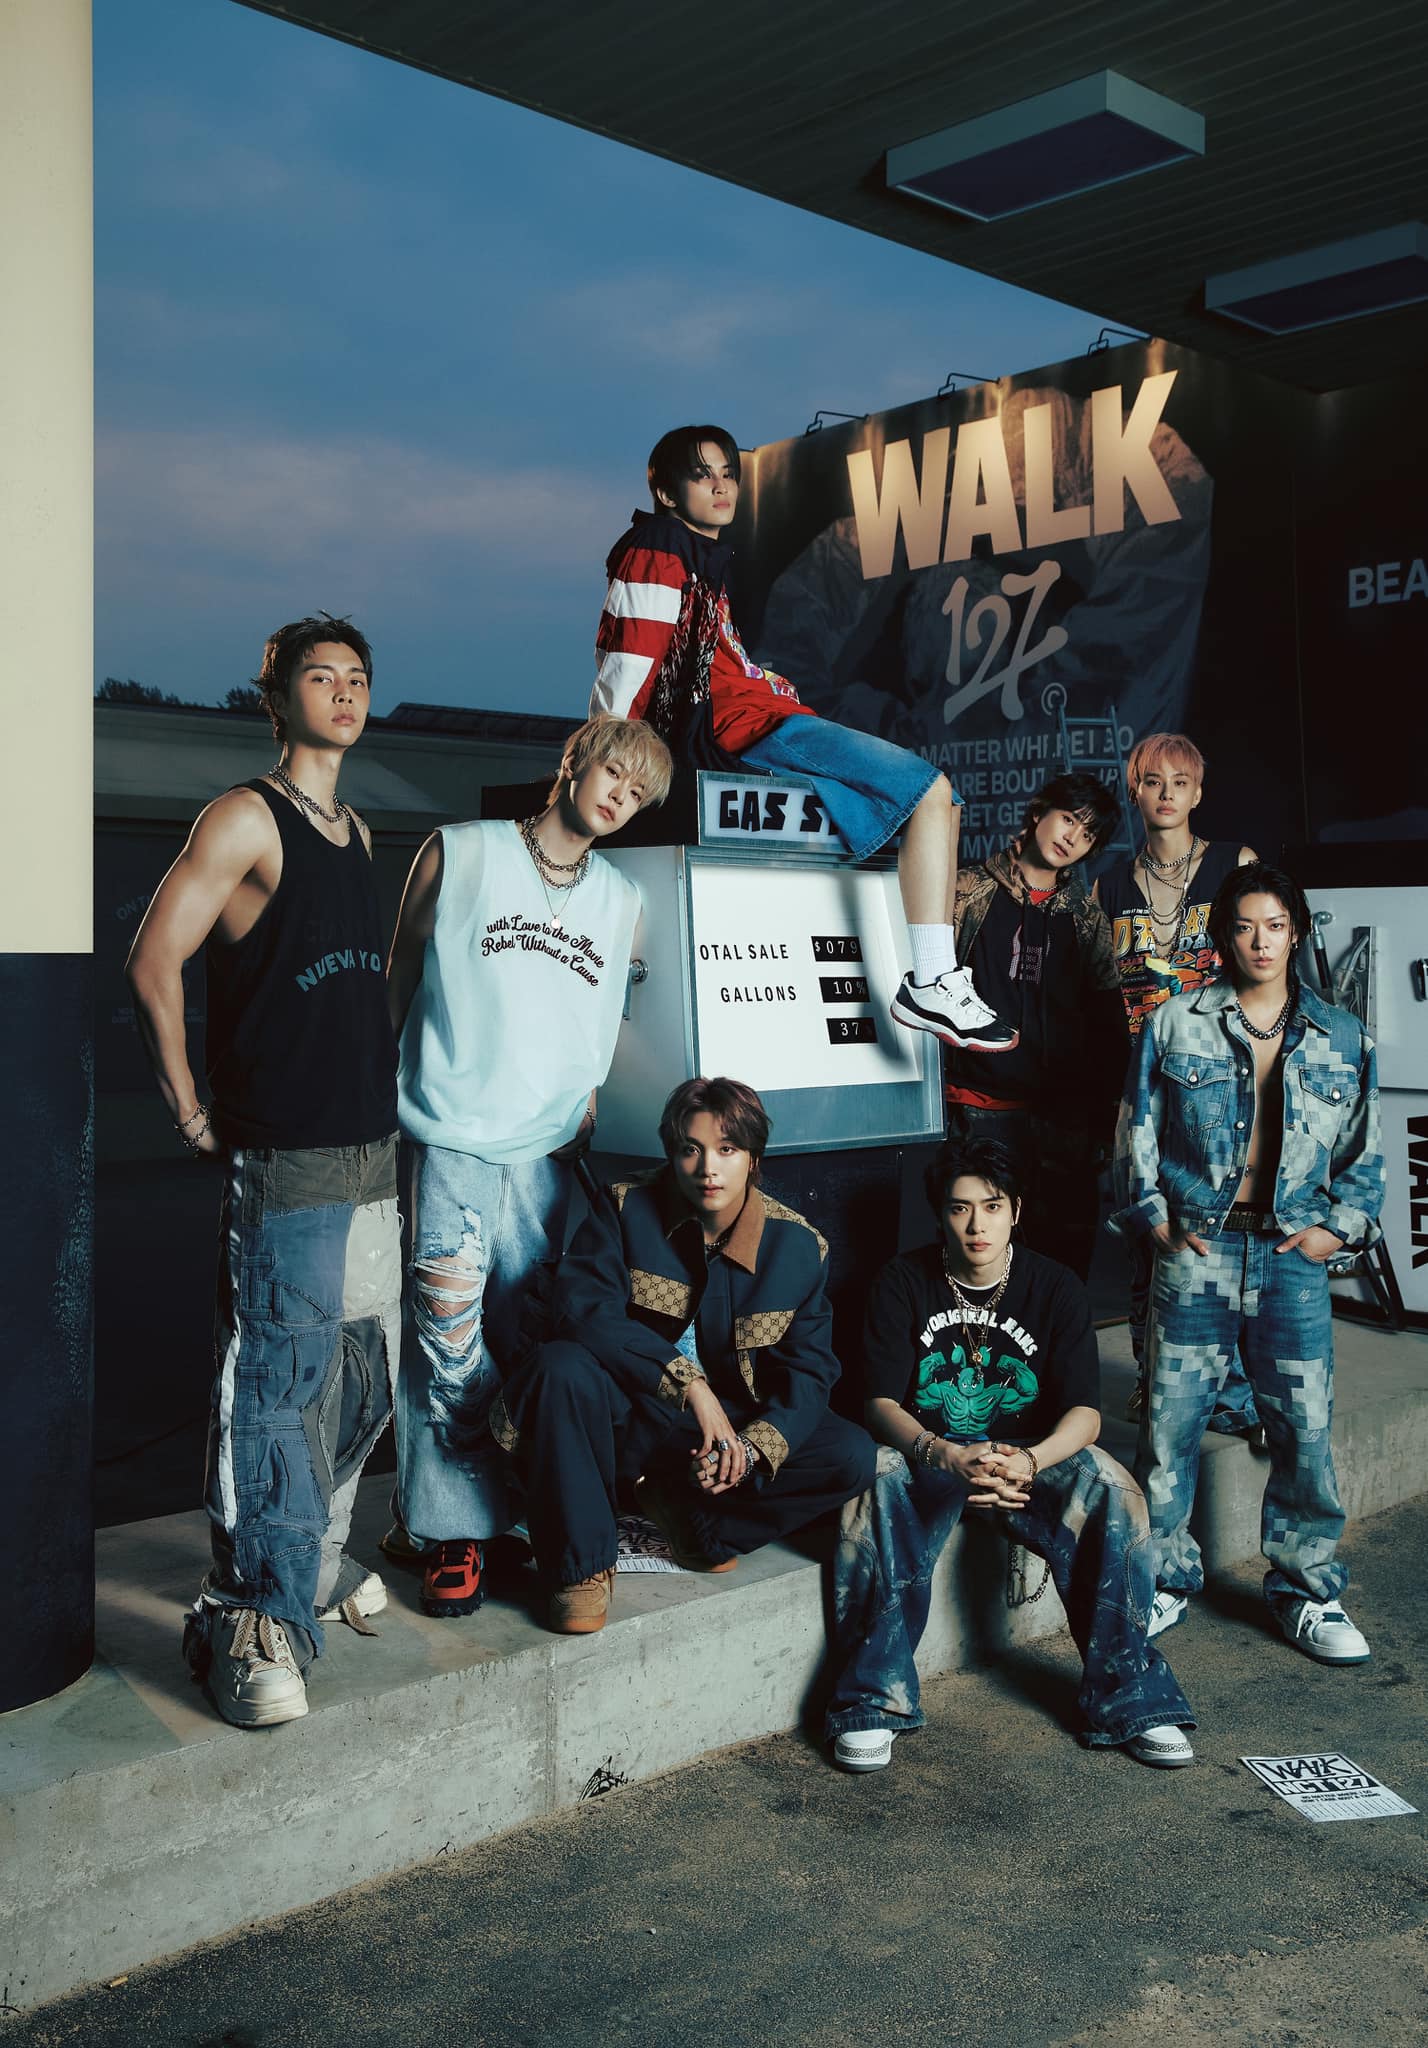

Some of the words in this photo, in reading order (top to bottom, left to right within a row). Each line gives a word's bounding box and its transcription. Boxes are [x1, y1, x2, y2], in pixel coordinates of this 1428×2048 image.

[847, 369, 1182, 580] WALK
[1348, 558, 1428, 608] BEA
[942, 559, 1069, 725] 127
[920, 741, 1002, 767] MATTER
[719, 790, 789, 832] GAS
[997, 801, 1030, 826] GE
[481, 935, 515, 957] Rebel
[515, 934, 560, 959] Without
[560, 954, 569, 964] a
[570, 954, 599, 986] Cause
[511, 914, 541, 932] Love
[542, 922, 551, 936] to
[570, 935, 604, 968] Movie
[700, 944, 743, 961] OTAL
[749, 943, 789, 960] SALE
[295, 948, 356, 993] NUEVA
[720, 985, 797, 1003] GALLONS
[1000, 1317, 1038, 1356] JEANS
[1256, 1757, 1352, 1779] WALK
[1274, 1781, 1330, 1796] NCT
[1325, 1776, 1370, 1790] 127
